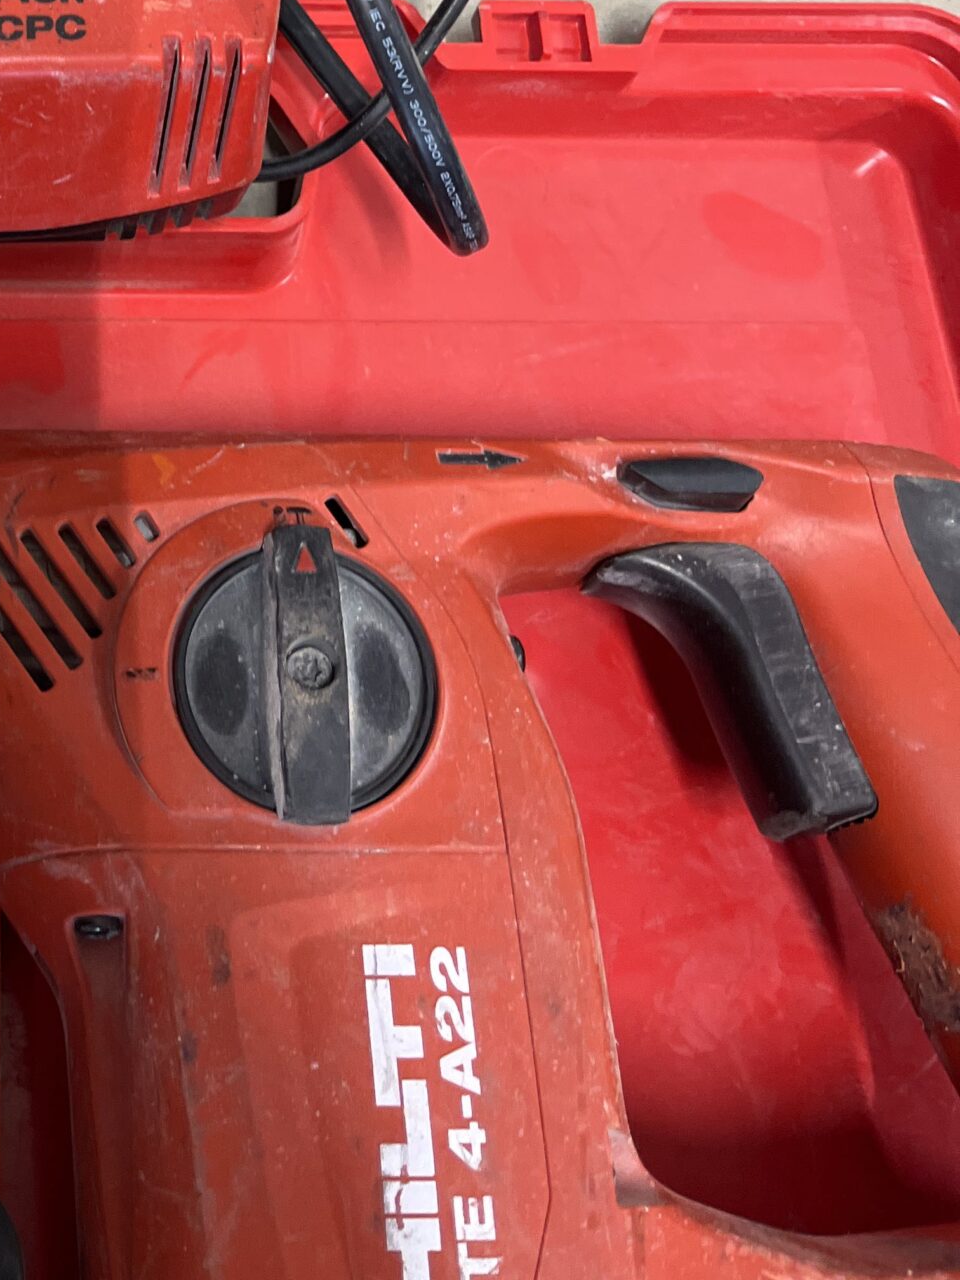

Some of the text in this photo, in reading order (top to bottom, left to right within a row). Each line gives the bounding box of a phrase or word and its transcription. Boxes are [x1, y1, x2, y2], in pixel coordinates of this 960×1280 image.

[382, 36, 414, 95] 53(RVV)
[409, 99, 445, 167] 300/500V
[429, 945, 486, 1170] 4-A22
